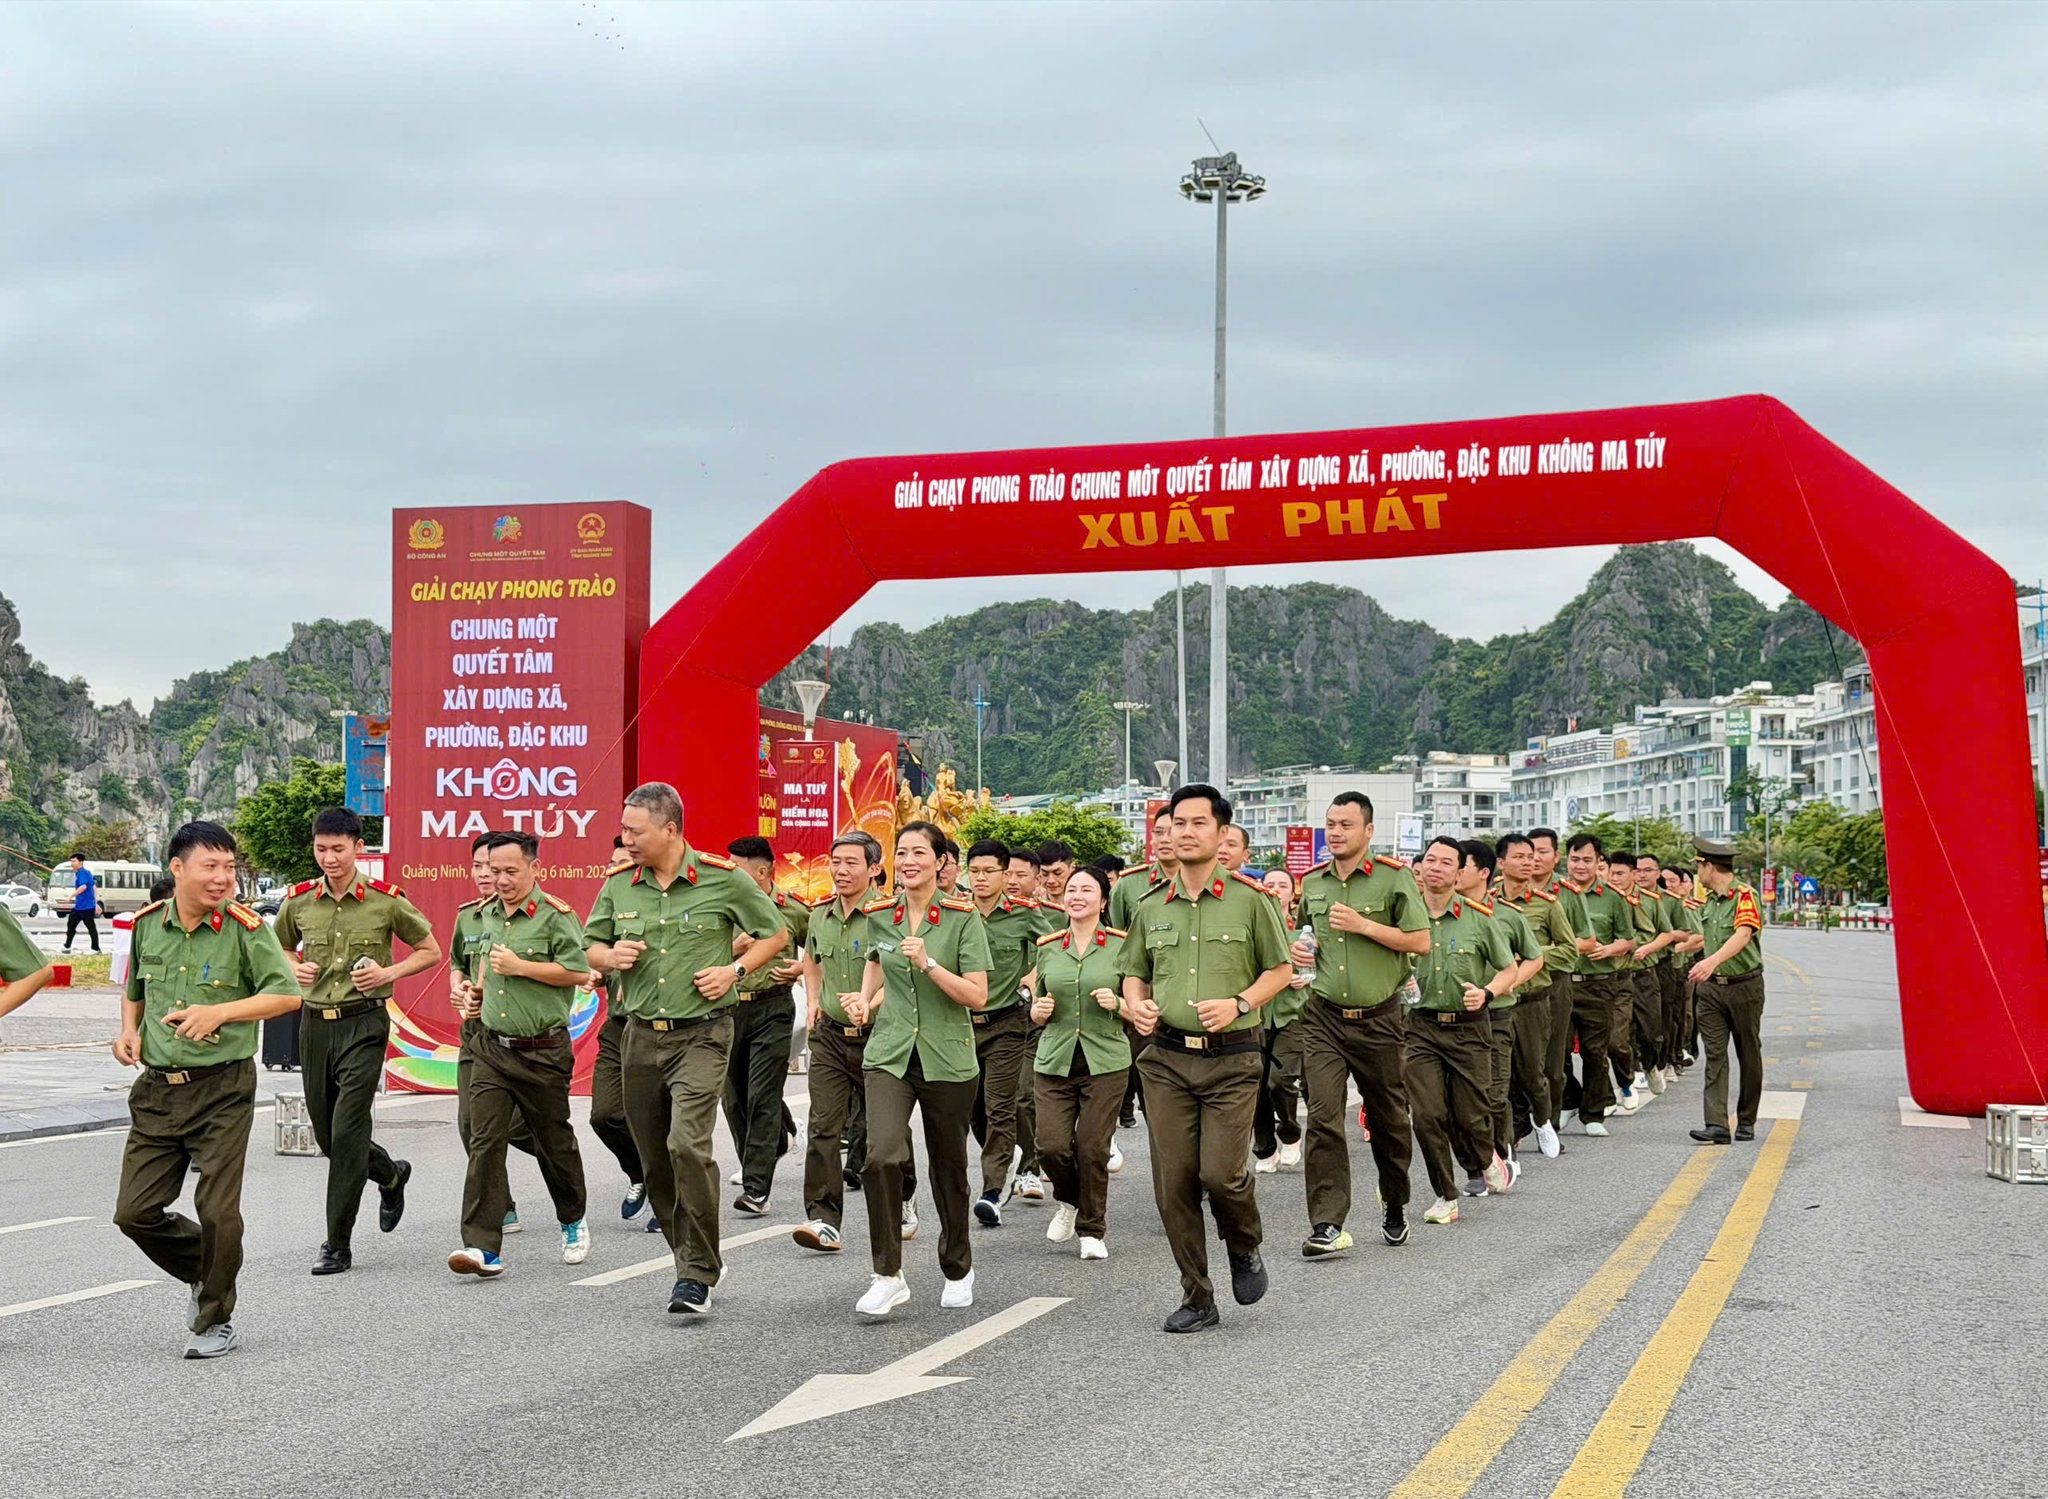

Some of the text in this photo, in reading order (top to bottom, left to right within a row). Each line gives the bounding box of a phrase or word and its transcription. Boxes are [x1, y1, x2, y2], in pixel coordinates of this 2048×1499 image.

[894, 471, 924, 509] GIẢI
[928, 477, 967, 512] CHẠY
[971, 474, 1021, 504] PHONG
[1029, 467, 1066, 502] TRÀO
[1070, 470, 1121, 501] CHUNG
[1166, 456, 1214, 498] QUYẾT
[1219, 457, 1253, 491] TÂM
[1259, 454, 1291, 489] XÂY
[1297, 454, 1341, 492] DỰNG
[1347, 449, 1375, 487] XÃ,
[1381, 444, 1453, 483] PHƯỜNG,
[1456, 442, 1491, 484] ĐẶC
[1497, 444, 1531, 476] KHU
[1537, 437, 1594, 474] KHÔNG
[1601, 439, 1628, 471] MA
[1634, 431, 1667, 469] TÚY
[1078, 487, 1448, 550] XUẤT PHÁT
[410, 572, 617, 606] GIẢI CHẠY PHONG TRÀO
[450, 612, 559, 644] CHUNG MỘT
[452, 646, 553, 676] QUYẾT TÂM
[442, 683, 568, 714] XÂY DỰNG XÃ,
[425, 721, 588, 752] PHƯỜNG, ĐẶC KHU
[436, 757, 578, 801] KHÔNG
[783, 783, 804, 795] MA
[420, 802, 598, 838] MA TÚY
[808, 808, 829, 820] HOẠ
[401, 863, 438, 882] Quảng
[440, 863, 469, 880] Ninh,
[549, 864, 557, 879] 6
[559, 864, 584, 879] năm
[586, 864, 606, 879] 202
